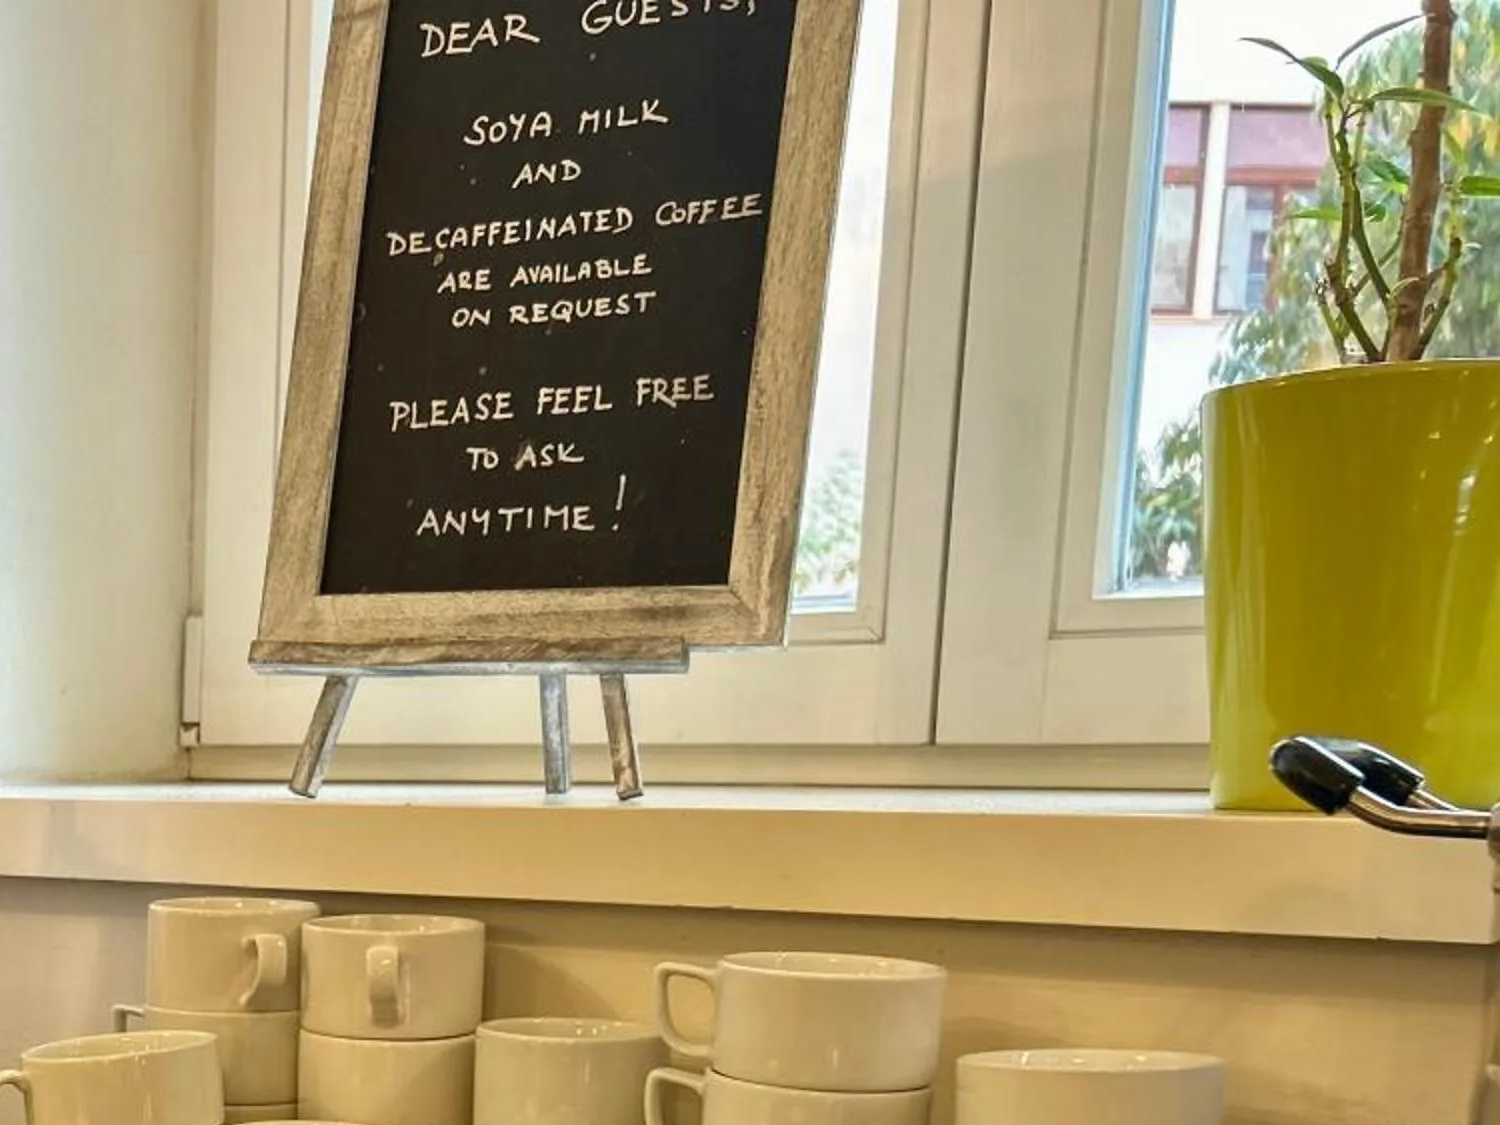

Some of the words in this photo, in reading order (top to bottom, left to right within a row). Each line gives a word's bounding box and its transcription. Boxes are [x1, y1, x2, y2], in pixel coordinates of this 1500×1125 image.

[419, 14, 540, 58] DEAR
[463, 110, 552, 145] SOYA
[578, 99, 669, 136] MILK
[512, 159, 581, 189] AND
[387, 207, 633, 257] DECAFFEINATED
[655, 193, 763, 226] COFFEE
[437, 268, 491, 294] ARE
[509, 253, 653, 288] AVAILABLE
[452, 305, 490, 329] ON
[509, 291, 657, 326] REQUEST
[391, 391, 514, 433] PLEASE
[536, 384, 613, 417] FEEL
[636, 374, 715, 408] FREE
[466, 445, 499, 471] TO
[514, 443, 585, 470] ASK
[416, 505, 595, 537] ANYTIME
